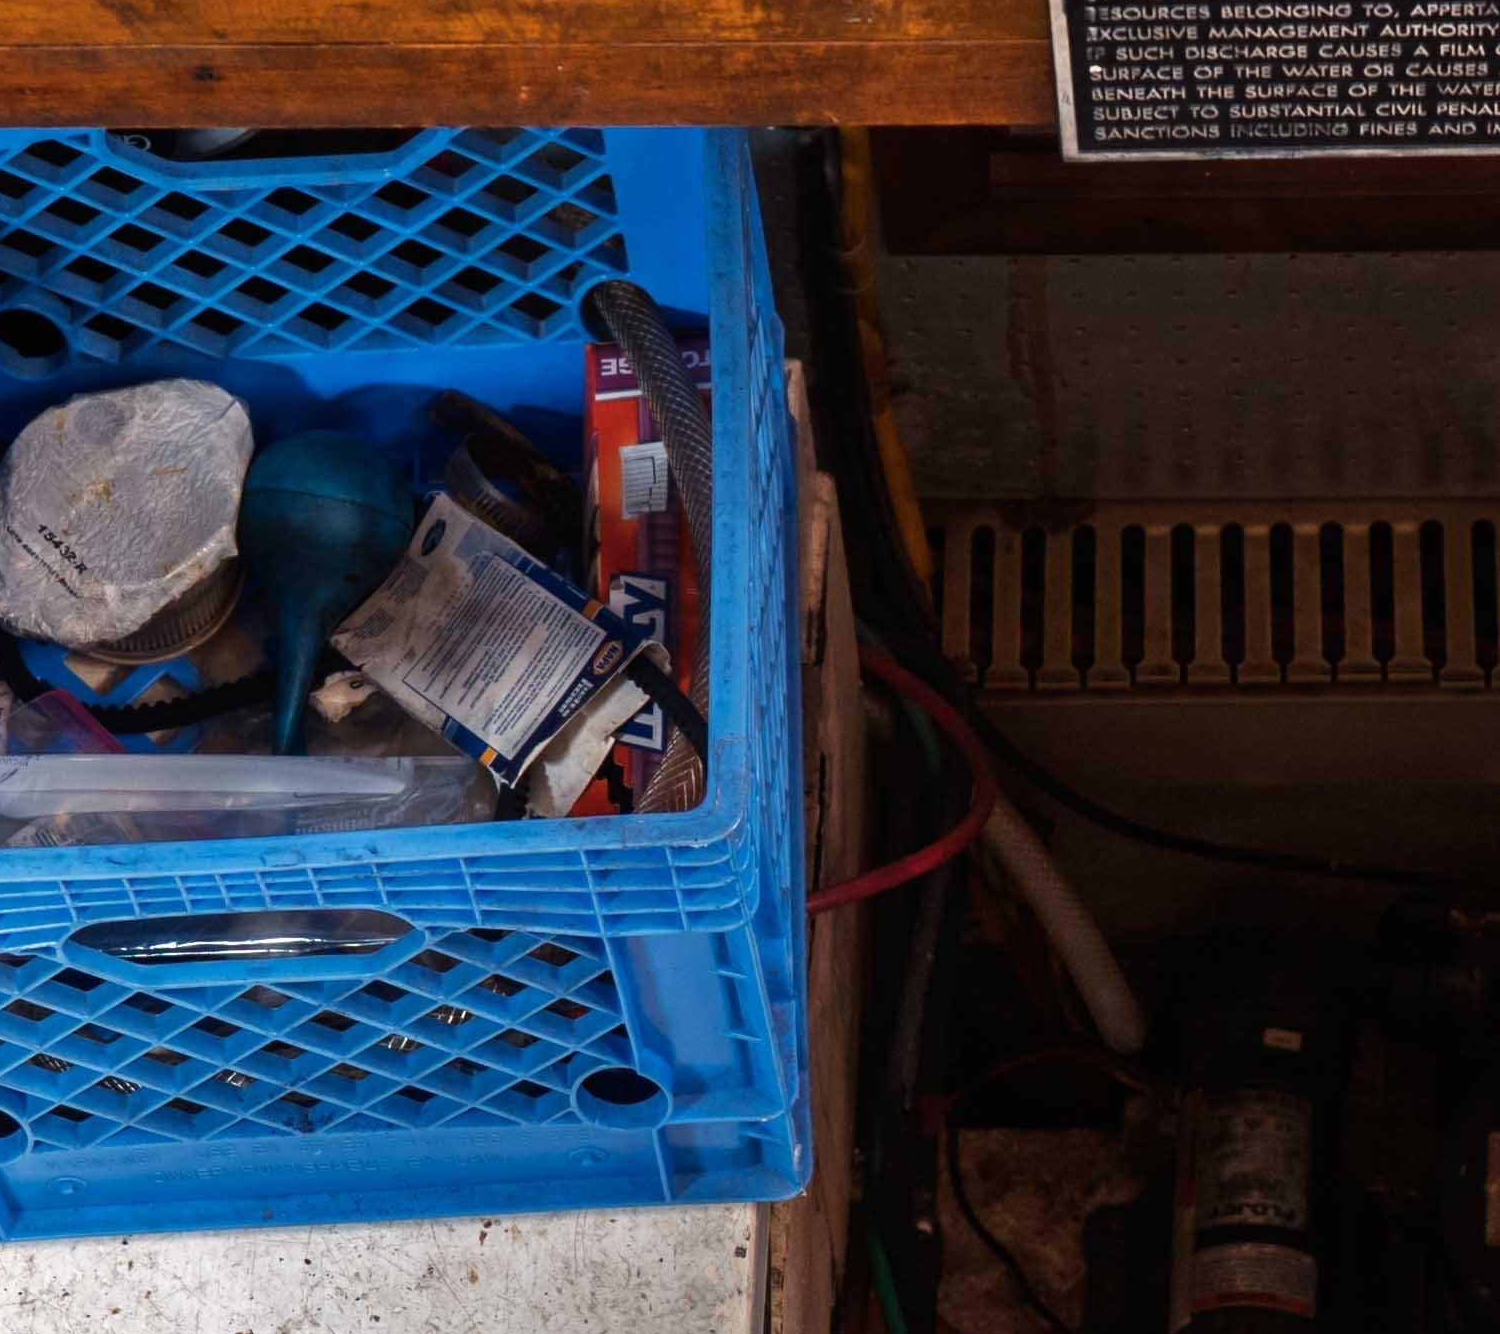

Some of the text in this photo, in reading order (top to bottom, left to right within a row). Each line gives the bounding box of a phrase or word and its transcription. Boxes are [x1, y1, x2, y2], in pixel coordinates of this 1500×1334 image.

[1221, 4, 1352, 19] BELONGING
[1362, 3, 1400, 19] TO,
[1208, 24, 1370, 40] MANAGEMENT
[1379, 23, 1500, 38] AUTHORITY
[1115, 45, 1175, 61] SUCH
[1184, 44, 1309, 60] DISCHARGE
[1318, 43, 1402, 59] CAUSES
[1413, 44, 1430, 57] A
[1439, 43, 1485, 57] FILM
[1089, 65, 1184, 82] SURFACE
[1193, 66, 1224, 79] OF
[1234, 65, 1273, 79] THE
[1282, 64, 1354, 78] WATER
[1363, 63, 1395, 78] OR
[1405, 63, 1489, 77] CAUSES
[1091, 86, 1186, 101] BENEATH
[1196, 85, 1236, 99] THE
[1244, 84, 1339, 99] SURFACE
[1348, 84, 1379, 97] OF
[1390, 83, 1427, 97] THE
[1092, 104, 1179, 121] SUBJECT
[1189, 105, 1220, 119] TO
[1229, 103, 1366, 119] SUBSTANTIAL
[1375, 102, 1427, 117] CIVIL
[1094, 124, 1221, 140] SANCTIONS
[1230, 122, 1349, 138] INCLUDING
[1359, 121, 1419, 136] FINES
[1428, 121, 1477, 136] AND
[596, 644, 618, 671] NAPA
